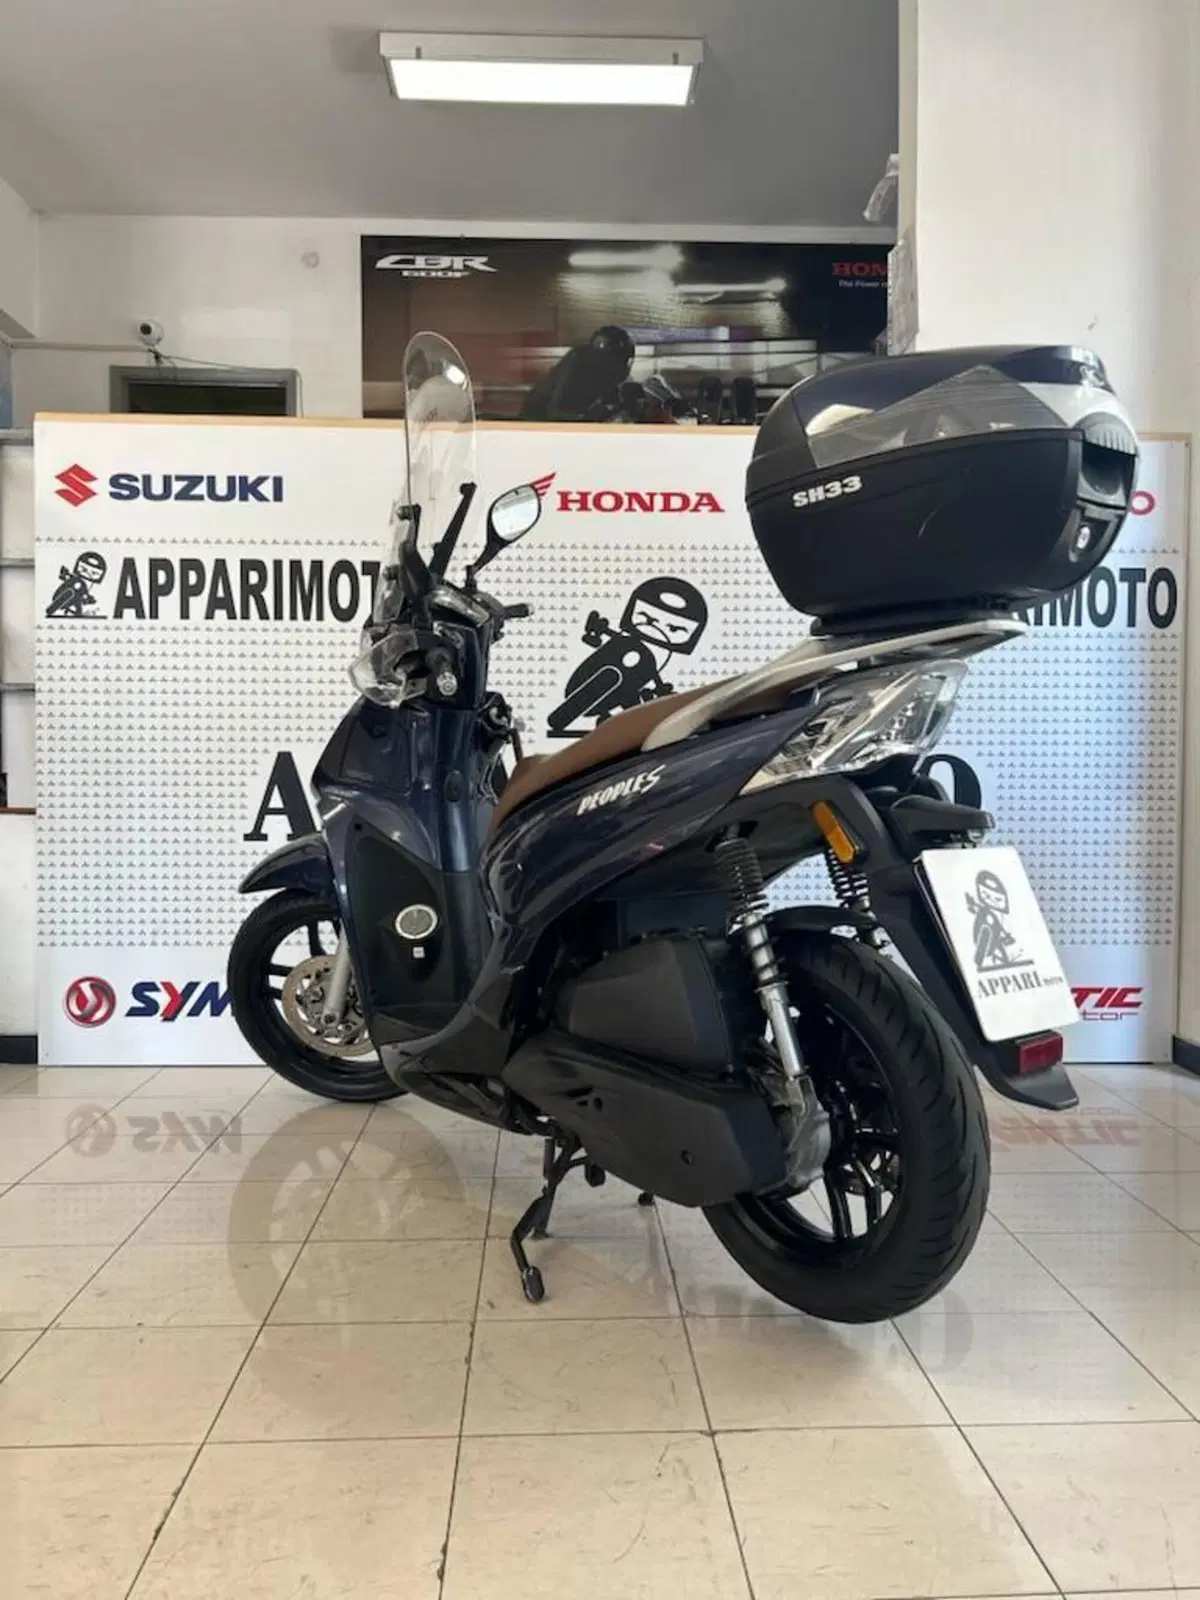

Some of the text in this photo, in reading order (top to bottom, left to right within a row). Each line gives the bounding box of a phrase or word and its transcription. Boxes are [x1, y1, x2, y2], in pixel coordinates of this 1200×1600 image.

[375, 254, 499, 272] CBR
[108, 473, 284, 502] SUZUKI
[557, 491, 725, 513] HONDA
[792, 475, 863, 508] SH33
[975, 969, 1042, 998] APPARI
[1070, 986, 1144, 1009] TIC
[125, 981, 233, 1022] SYM
